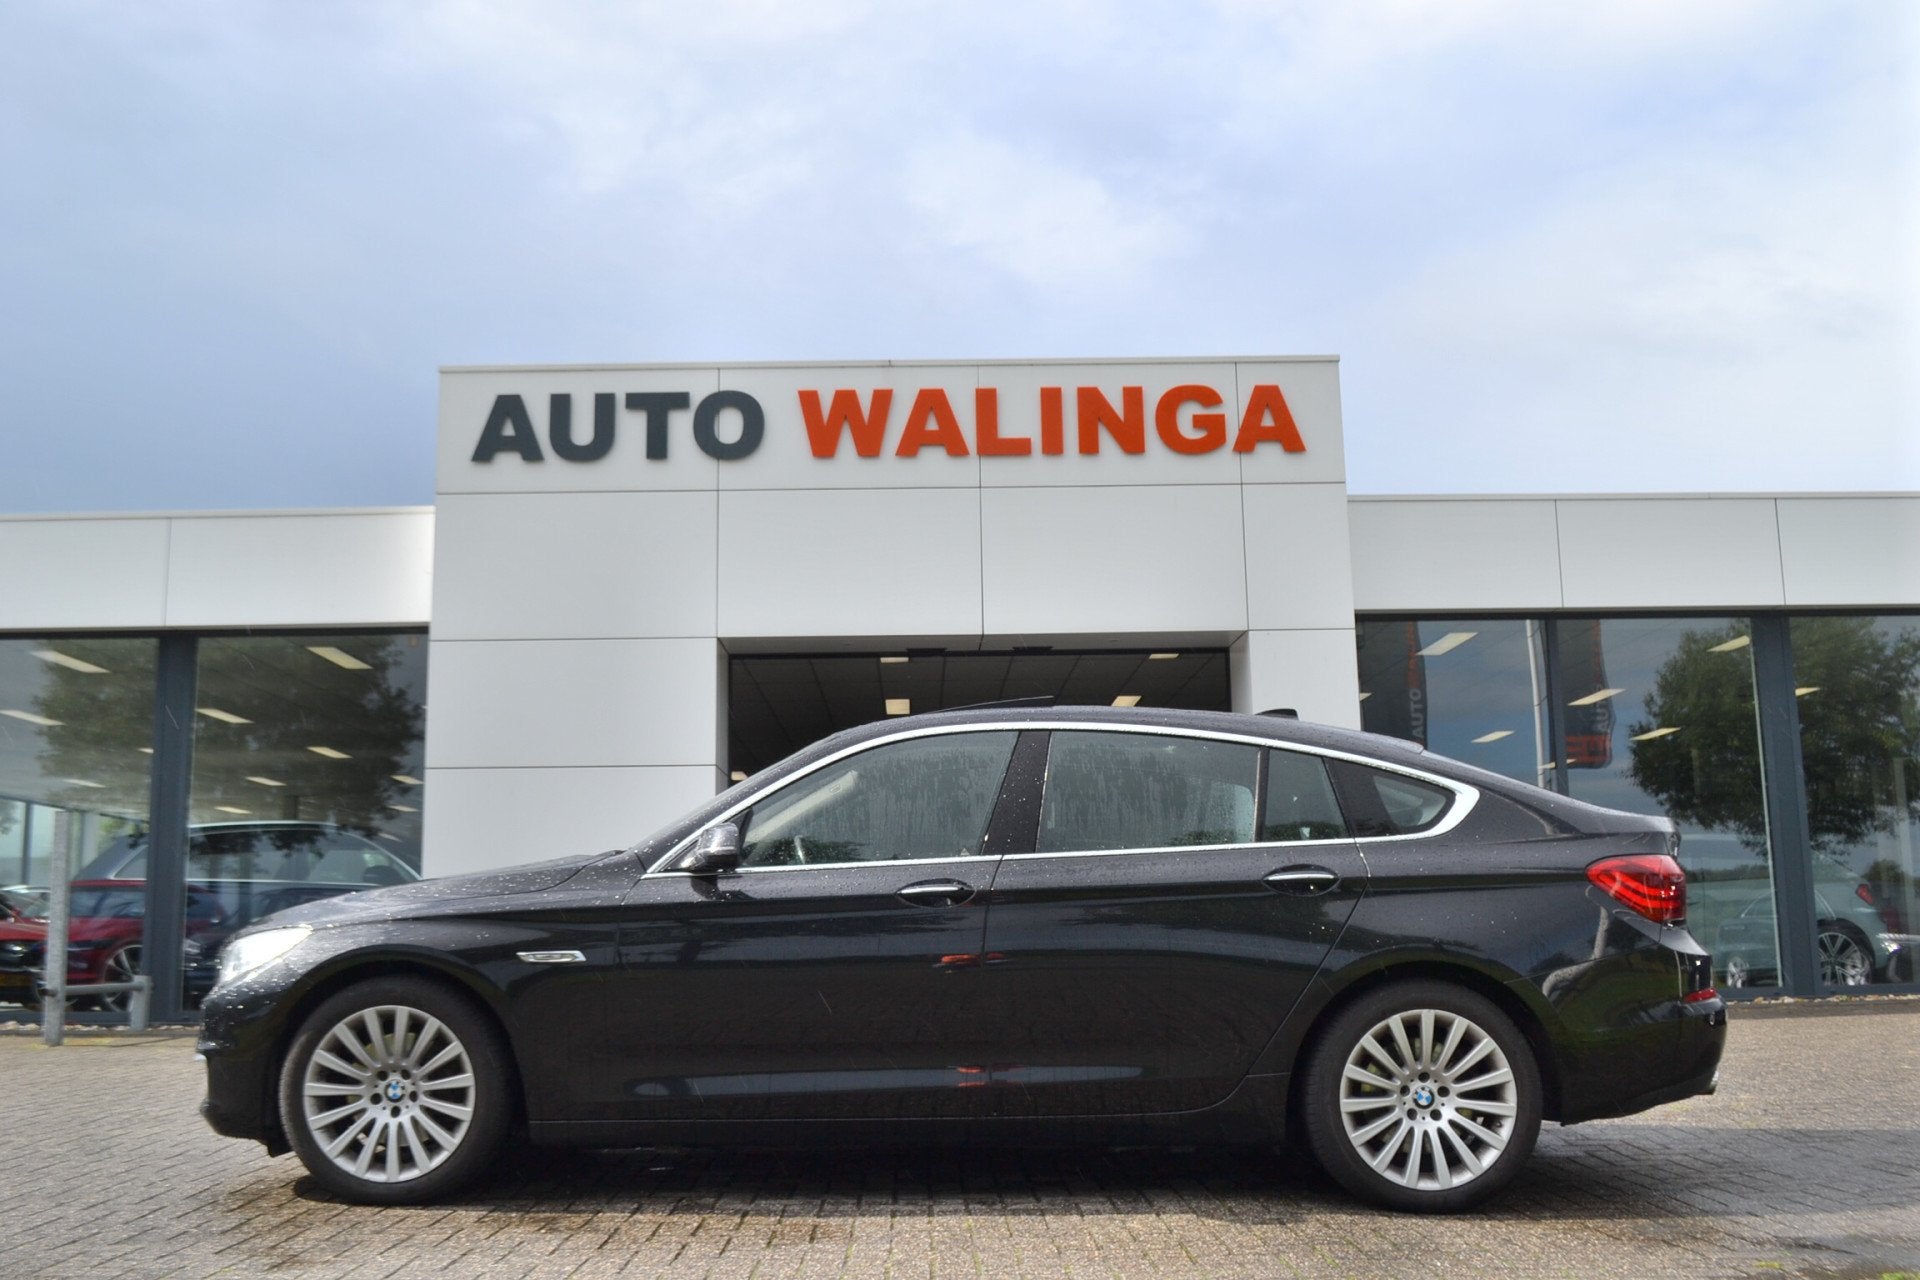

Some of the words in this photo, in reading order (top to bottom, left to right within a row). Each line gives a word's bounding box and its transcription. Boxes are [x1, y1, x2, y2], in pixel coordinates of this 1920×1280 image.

[471, 390, 765, 464] AUTO
[798, 384, 1306, 458] WALINGA
[1408, 688, 1425, 739] AUTO
